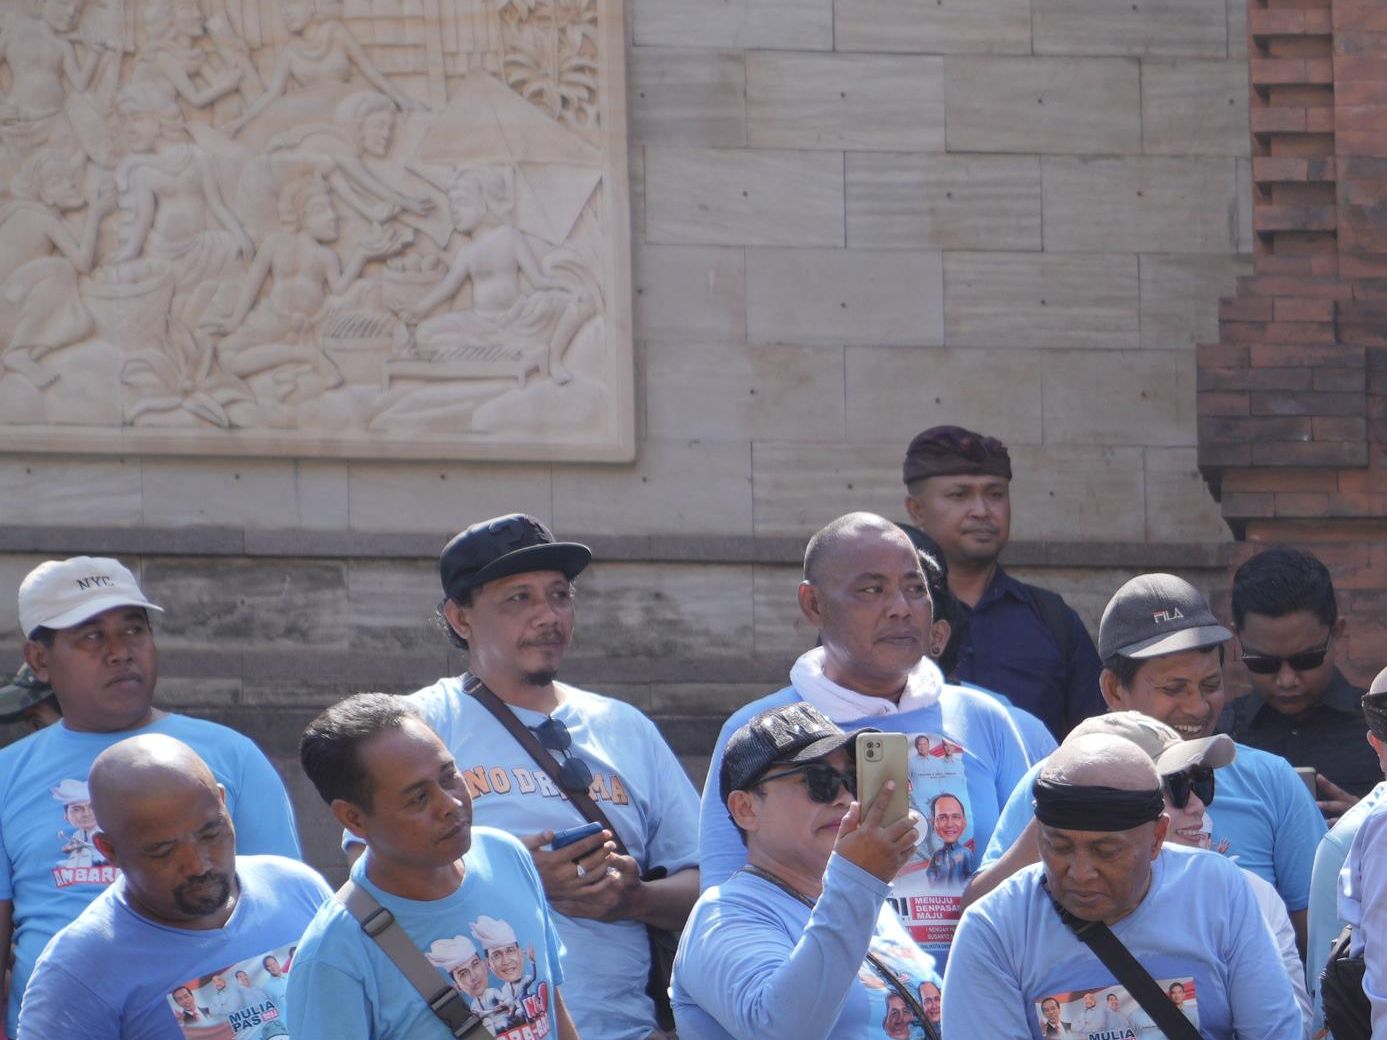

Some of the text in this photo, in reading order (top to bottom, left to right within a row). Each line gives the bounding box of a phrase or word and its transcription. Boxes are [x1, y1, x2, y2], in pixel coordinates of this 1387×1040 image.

[1153, 607, 1185, 623] FILA
[463, 765, 629, 805] NO DRMA
[228, 1000, 276, 1023] MULIA
[232, 1015, 262, 1033] PAS
